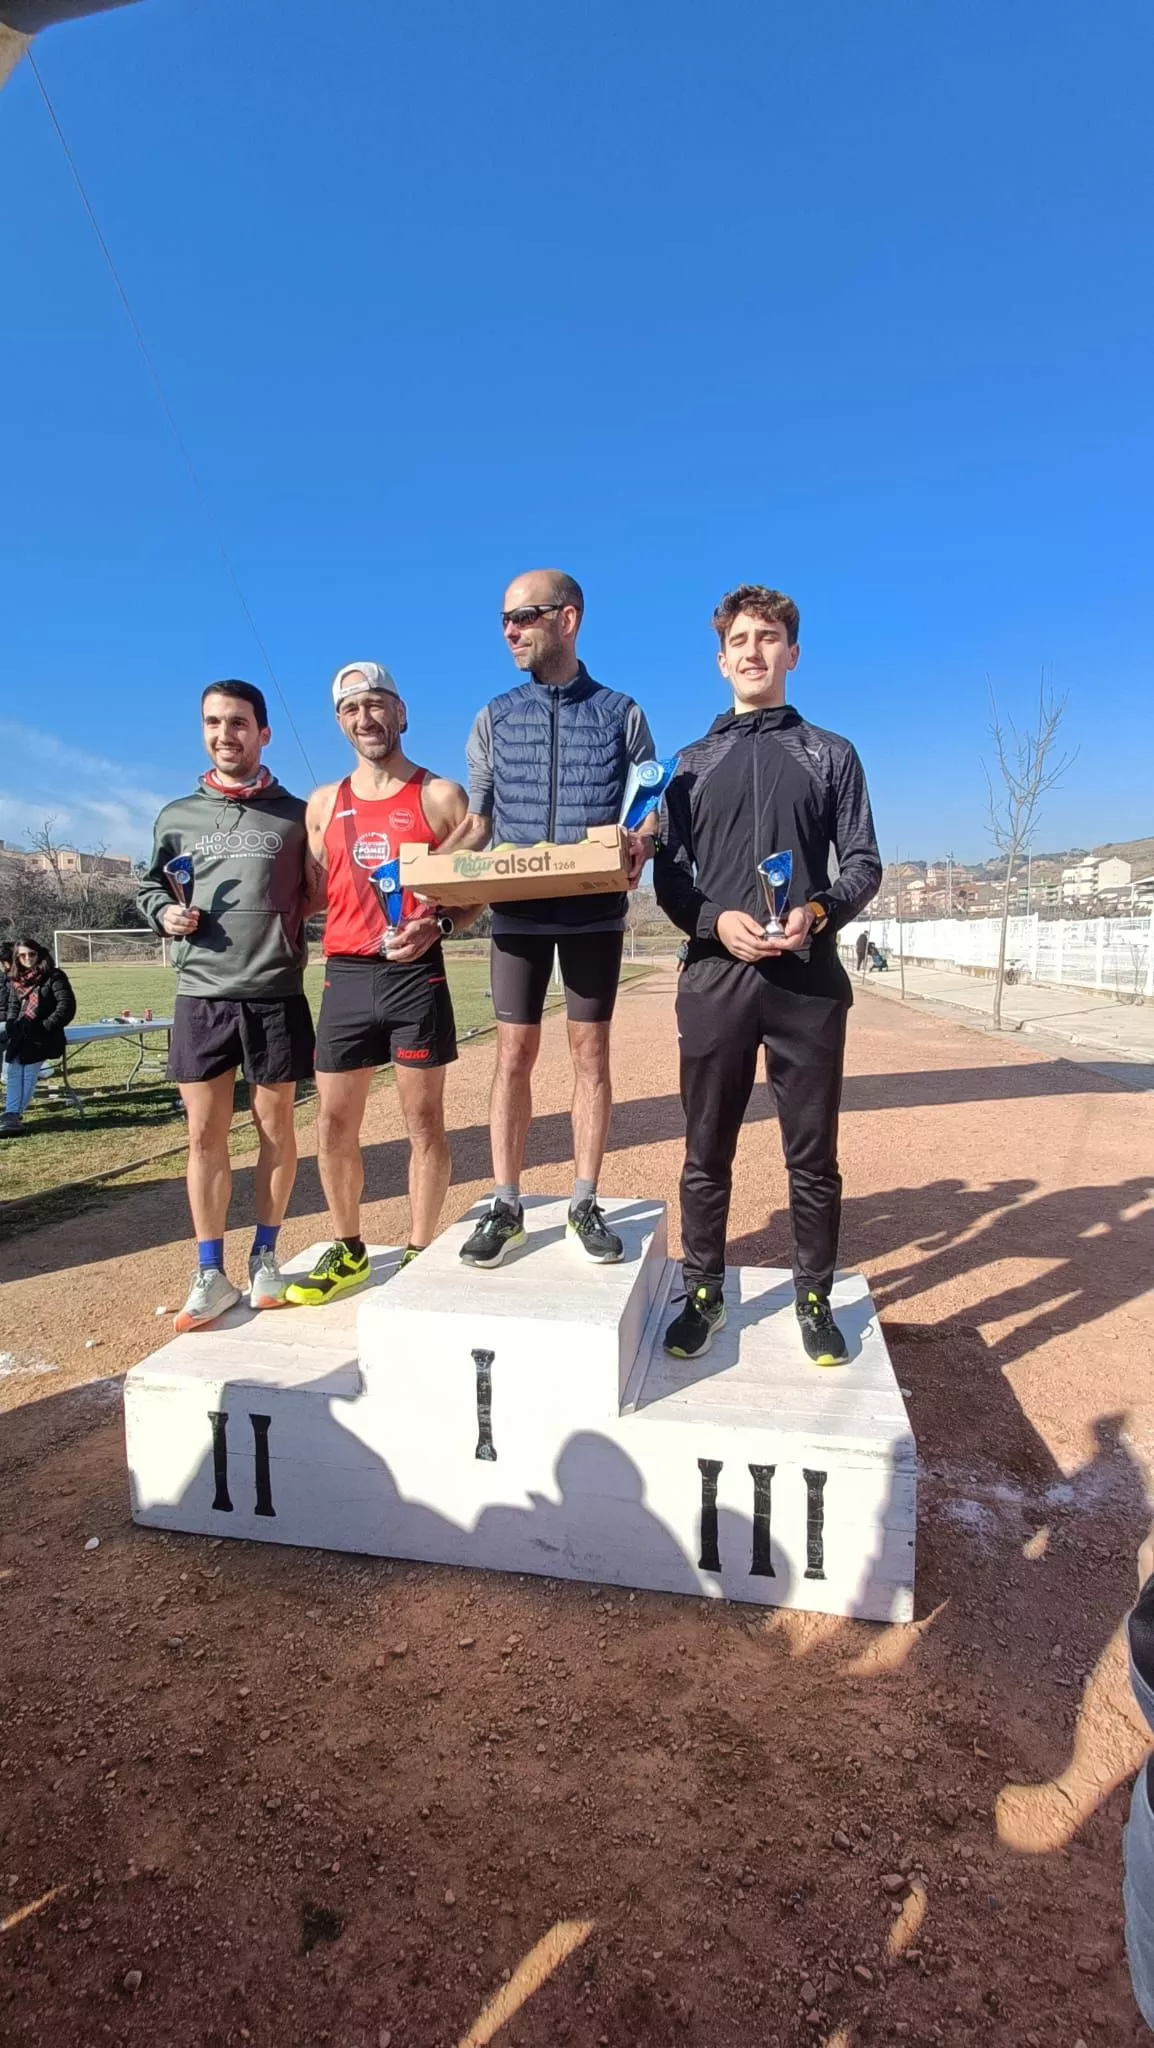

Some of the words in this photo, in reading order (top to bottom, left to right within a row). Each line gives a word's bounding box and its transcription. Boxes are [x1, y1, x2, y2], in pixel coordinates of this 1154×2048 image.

[553, 861, 576, 871] 1268
[471, 1348, 497, 1462] I
[207, 1411, 277, 1517] II
[697, 1457, 828, 1580] III
